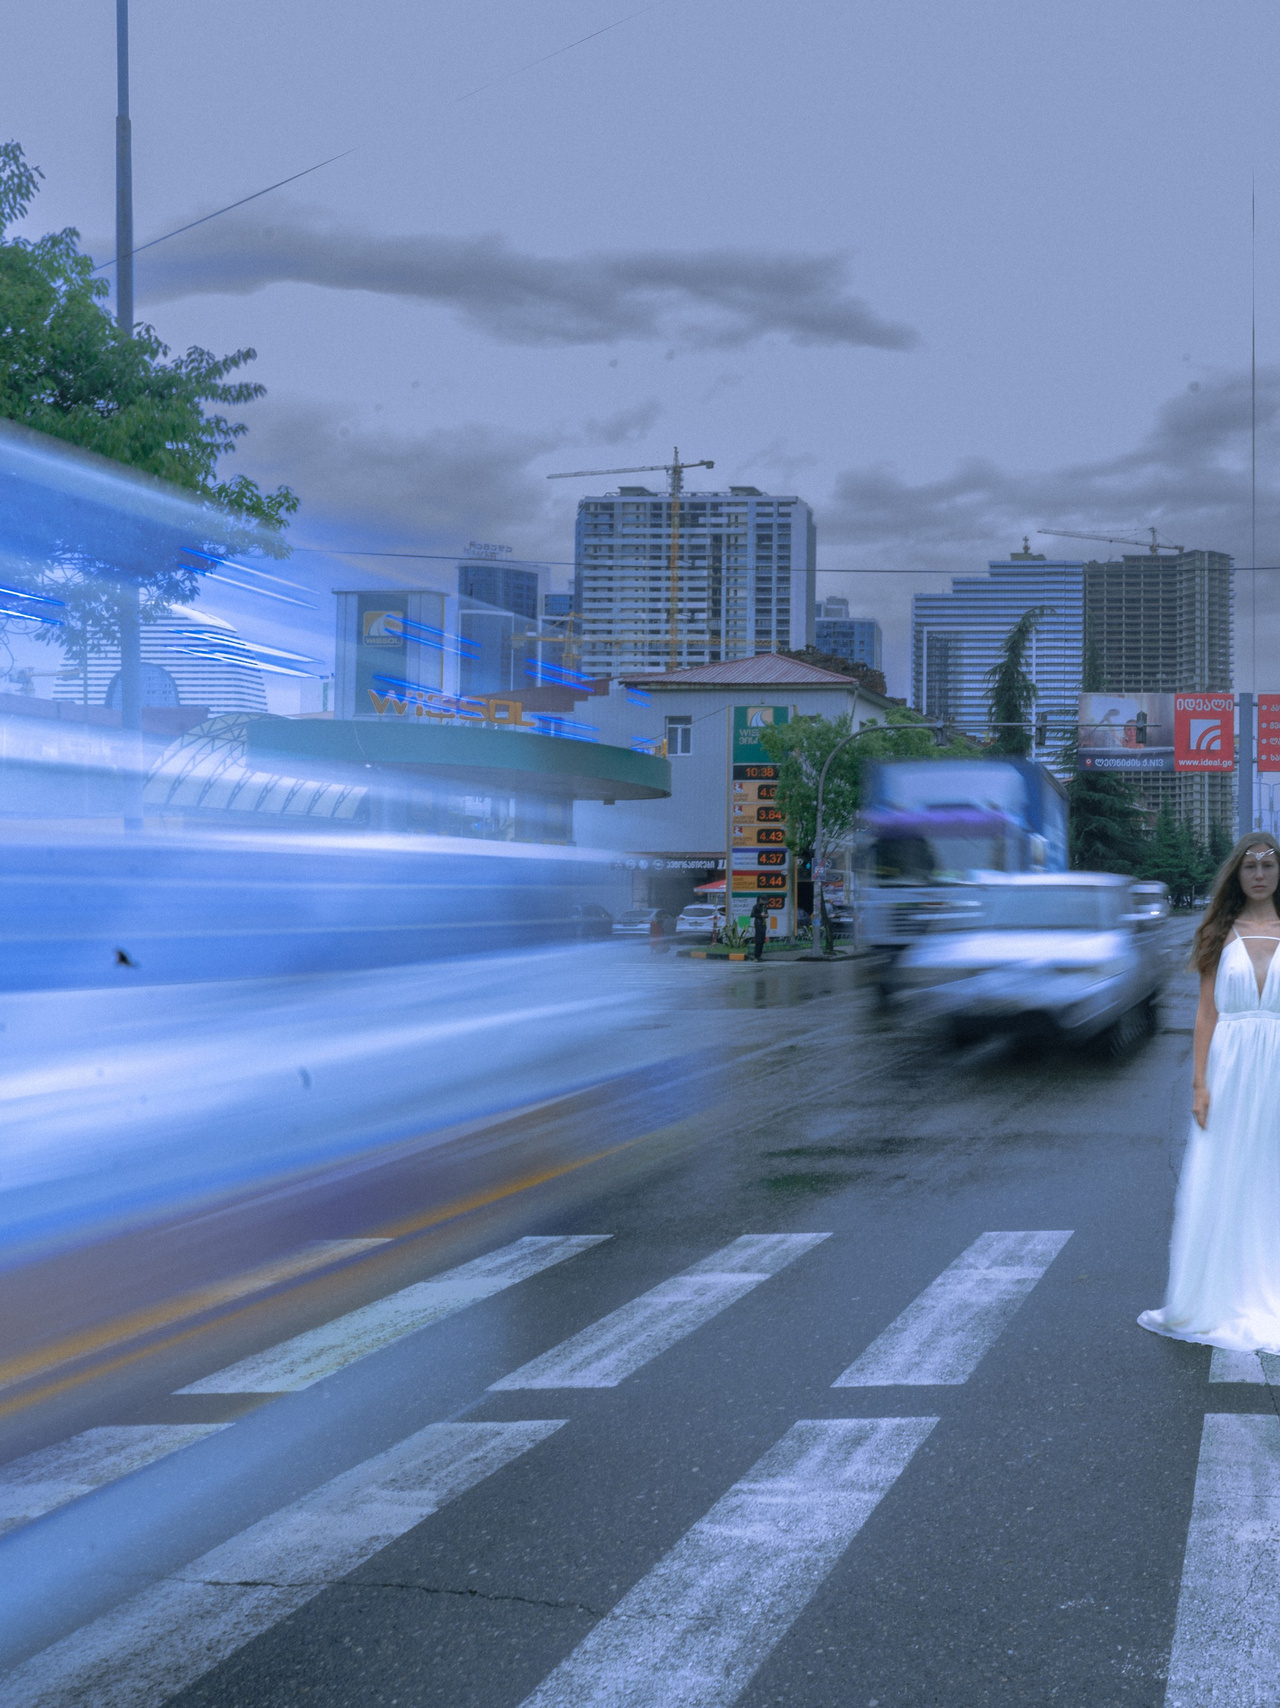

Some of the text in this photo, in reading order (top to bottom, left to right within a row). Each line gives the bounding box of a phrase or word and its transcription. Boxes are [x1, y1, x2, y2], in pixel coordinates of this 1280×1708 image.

[366, 637, 400, 645] WISSOL
[368, 689, 536, 727] WISSOL
[1176, 698, 1234, 711] იდეალი
[1178, 758, 1233, 768] www.ideal.ge
[746, 767, 775, 777] 10:38
[759, 809, 782, 820] 3.84
[759, 831, 783, 841] 4.43
[760, 853, 783, 863] 4.37
[759, 876, 783, 886] 3.44
